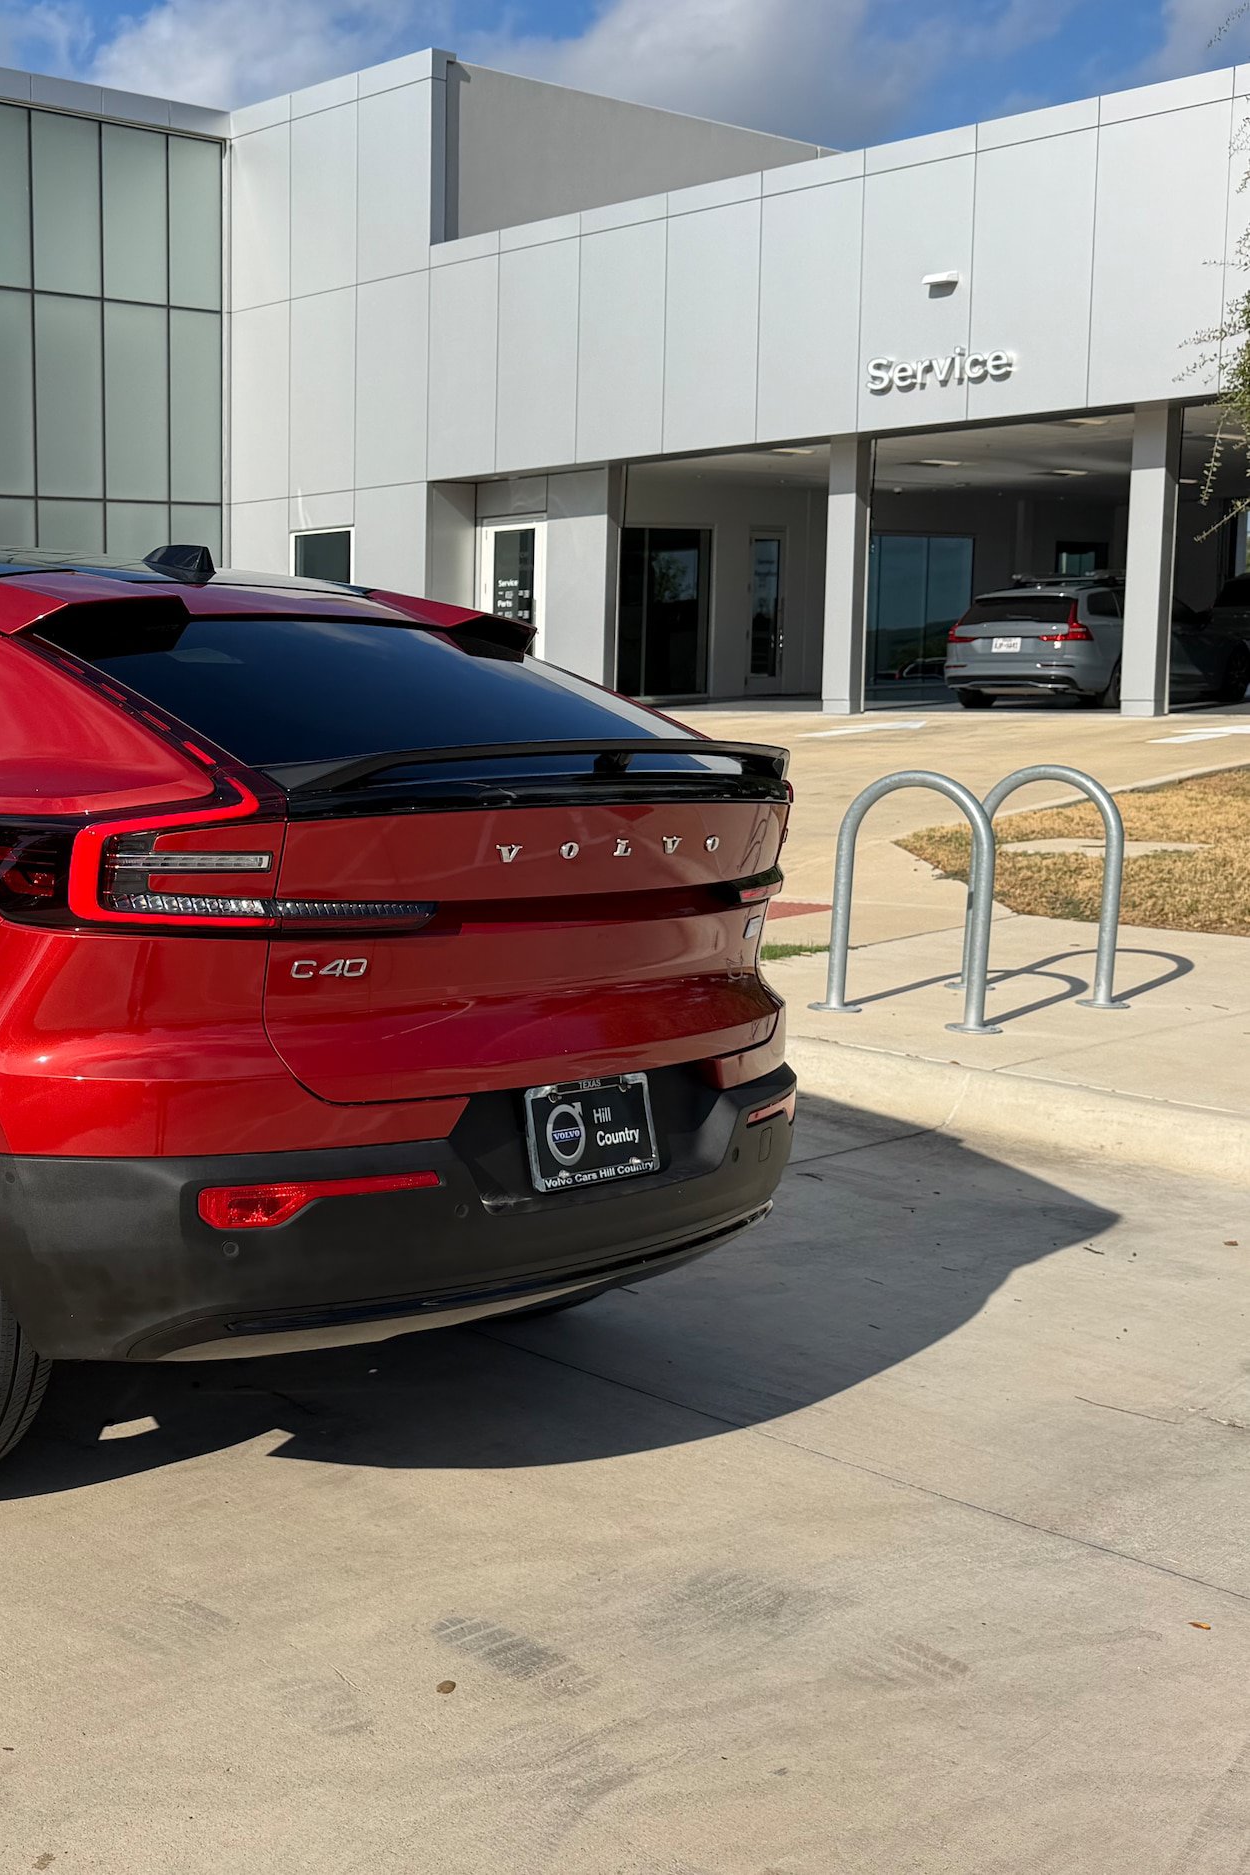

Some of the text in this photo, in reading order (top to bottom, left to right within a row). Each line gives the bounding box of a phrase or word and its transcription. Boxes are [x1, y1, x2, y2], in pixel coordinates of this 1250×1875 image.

[866, 346, 1013, 391] Service
[498, 578, 518, 587] Service
[497, 599, 512, 607] Parts
[495, 834, 720, 863] VOLVO
[290, 958, 367, 978] C40
[578, 1079, 601, 1090] TEXAS
[593, 1107, 611, 1124] Hill
[553, 1129, 580, 1141] VOLVO
[596, 1127, 640, 1146] Country
[545, 1160, 654, 1189] Volvo Cars Hill Country
